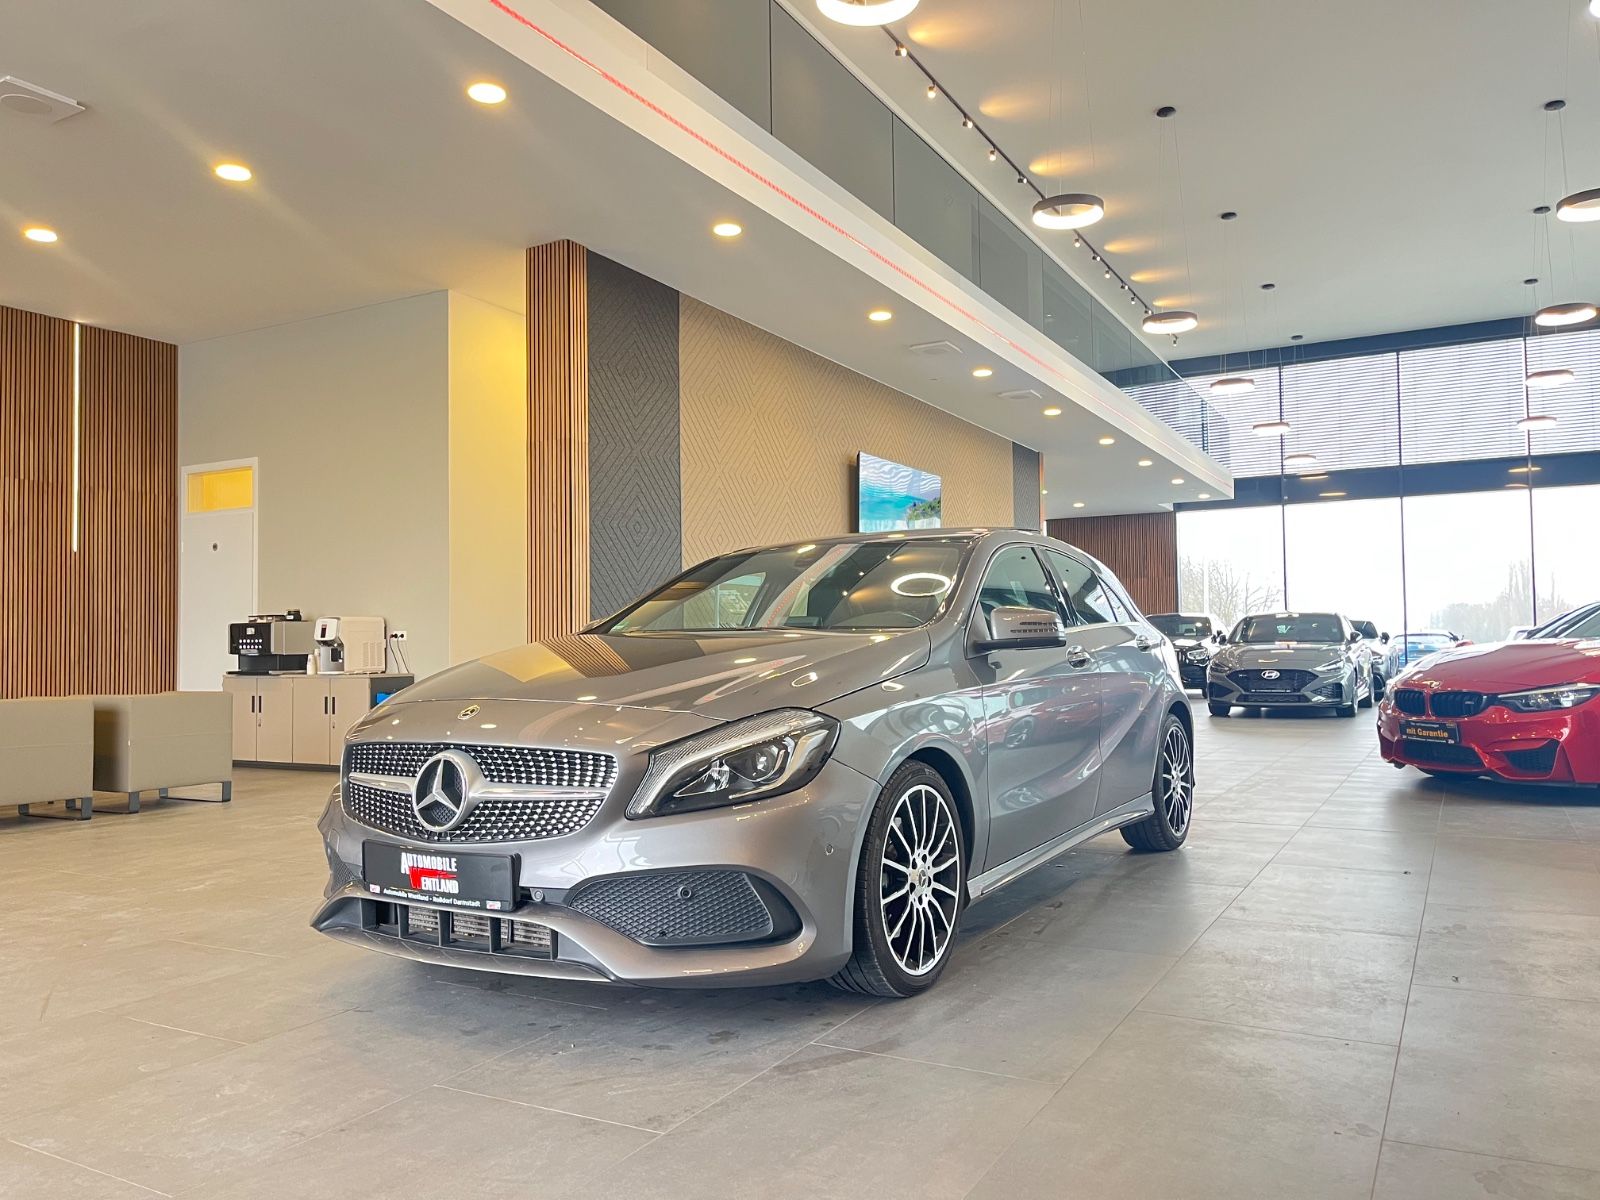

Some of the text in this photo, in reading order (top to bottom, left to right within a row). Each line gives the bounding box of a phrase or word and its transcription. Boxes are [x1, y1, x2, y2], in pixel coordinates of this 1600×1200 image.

[1417, 728, 1448, 737] Garantie
[400, 852, 458, 875] AUTOMOBILE
[453, 898, 481, 907] Darmstadt
